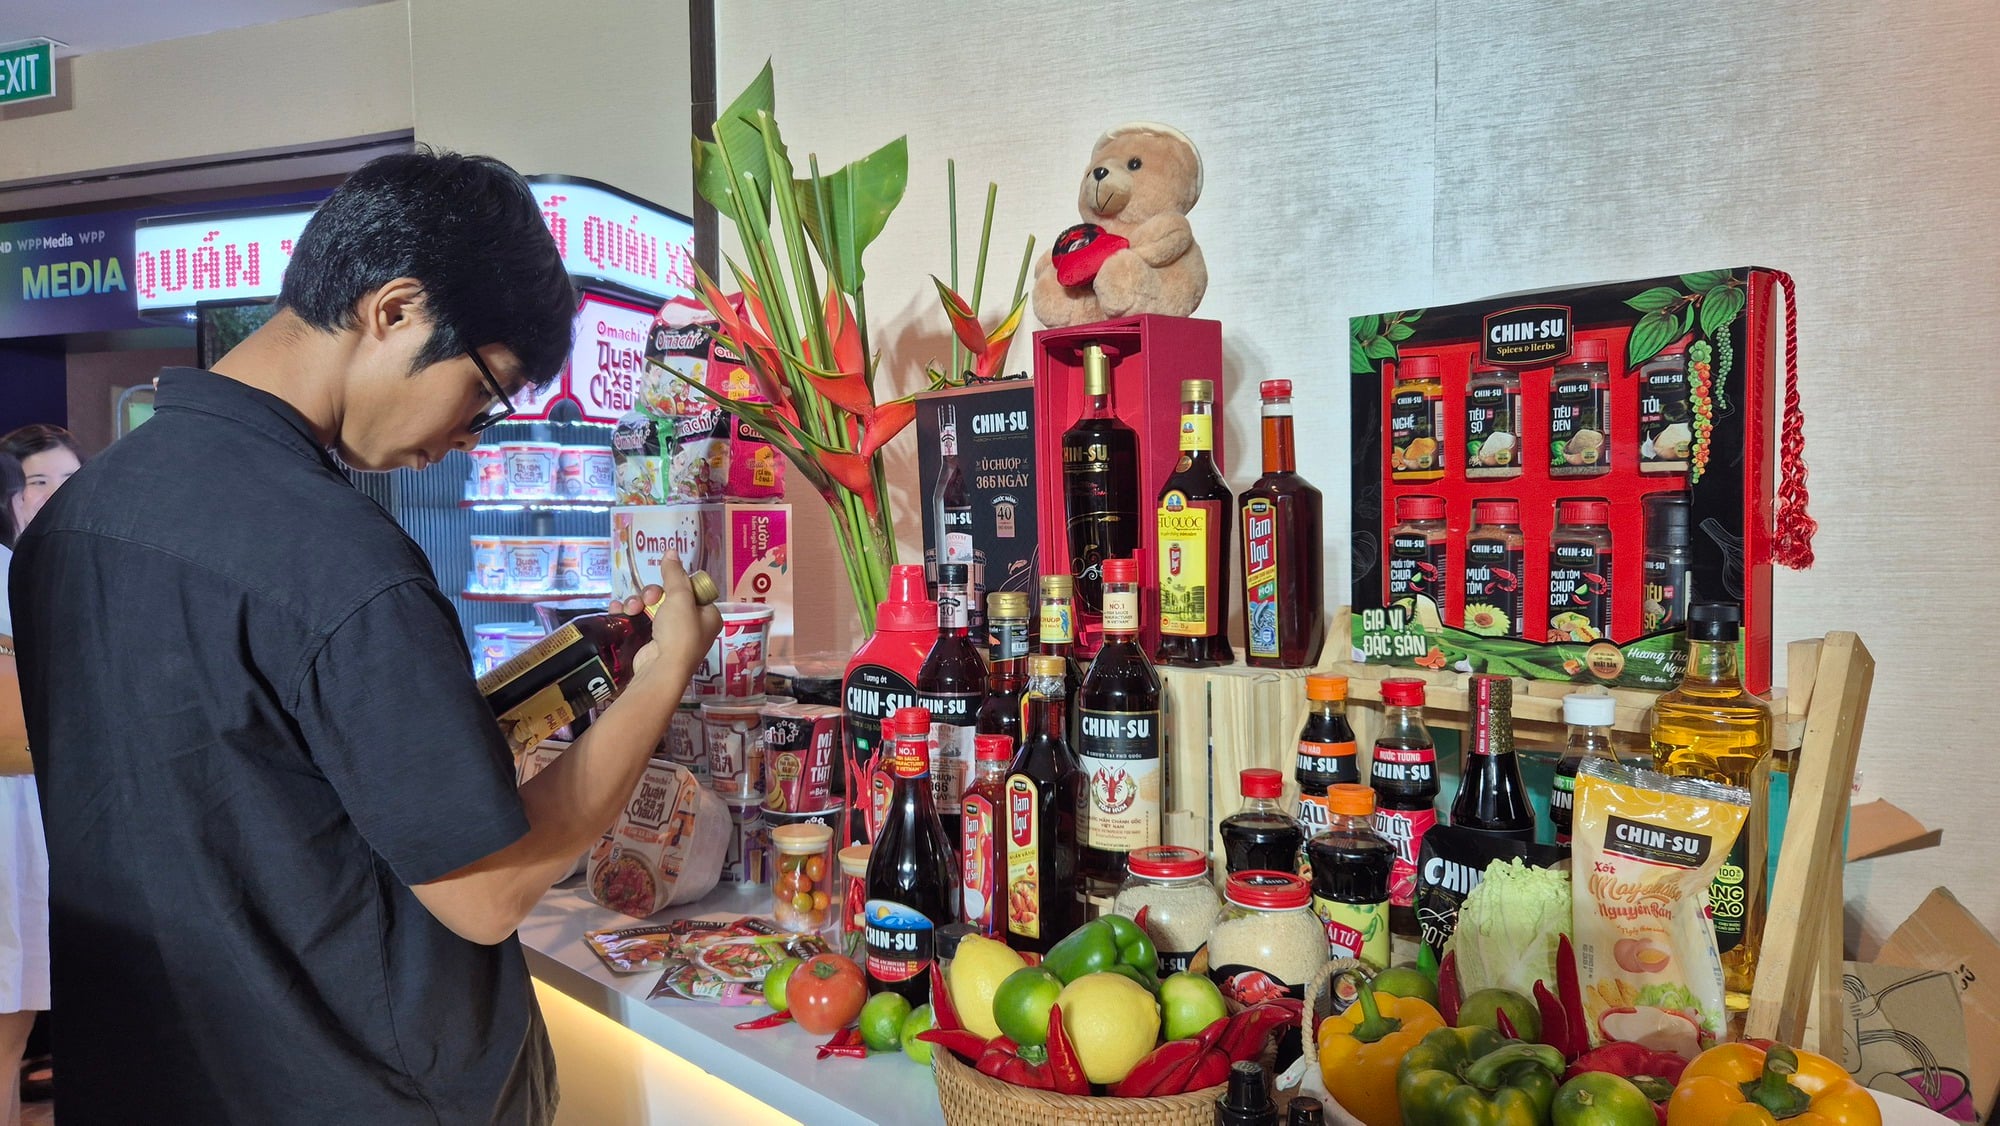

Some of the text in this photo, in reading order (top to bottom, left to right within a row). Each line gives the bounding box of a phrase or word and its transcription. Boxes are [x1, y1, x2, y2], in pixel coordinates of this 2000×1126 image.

[78, 230, 106, 244] WPP
[583, 215, 657, 279] QUÁN
[137, 230, 261, 299] QUÁN
[22, 257, 128, 301] MEDIA
[597, 320, 641, 343] Omachi
[1491, 318, 1563, 343] CHIN-SU
[656, 329, 699, 352] Omachi
[1496, 344, 1523, 357] Spices
[1530, 343, 1556, 352] Herbs
[1649, 375, 1683, 384] CHIN-SU
[1474, 388, 1502, 398] CHIN-SU
[1558, 384, 1589, 394] CHIN-SU
[1397, 396, 1423, 405] CHIN-SU
[1642, 396, 1660, 414] TỎI
[1468, 408, 1486, 422] TIÊU
[1552, 404, 1571, 419] TIÊU
[680, 410, 713, 437] achi
[972, 411, 1027, 434] CHIN-SU
[1392, 414, 1415, 430] NGHỆ
[1470, 421, 1483, 434] SỌ
[1552, 419, 1571, 432] ĐEN
[1064, 444, 1108, 462] HIN-SU
[990, 457, 1021, 473] CHƯỢP
[976, 471, 1029, 489] 365 NGÀY
[998, 507, 1012, 520] 40
[758, 516, 770, 551] Sườn
[1249, 517, 1271, 541] Nam
[636, 529, 688, 553] Omachi
[1395, 539, 1425, 548] CHIN-SU
[1471, 544, 1504, 554] CHIN-SU
[1557, 547, 1593, 557] CHIN-SU
[1391, 569, 1411, 580] CHUA
[1466, 564, 1490, 581] MUỐI
[1551, 568, 1581, 580] MUỐI TÔM
[1391, 581, 1407, 593] CAY
[1466, 582, 1483, 595] TÔM
[1551, 580, 1575, 593] CHUA
[1551, 594, 1569, 606] CAY
[1363, 609, 1404, 633] GIA VỊ
[1363, 631, 1427, 659] ĐẶC SẢN
[1627, 648, 1665, 664] Hương
[847, 687, 912, 718] CHIN-SU
[918, 698, 967, 714] CHIN-SU
[1082, 716, 1149, 738] CHIN-SU
[816, 748, 831, 767] LY
[898, 747, 916, 755] NO.1
[1372, 761, 1430, 780] CHIN-SU
[1013, 794, 1029, 813] Nam
[1616, 824, 1699, 855] CHIN-SU
[1424, 857, 1483, 893] CHIN
[1594, 861, 1616, 874] Xốt
[1599, 901, 1651, 920] Nguyên
[865, 926, 917, 950] CHIN-SU
